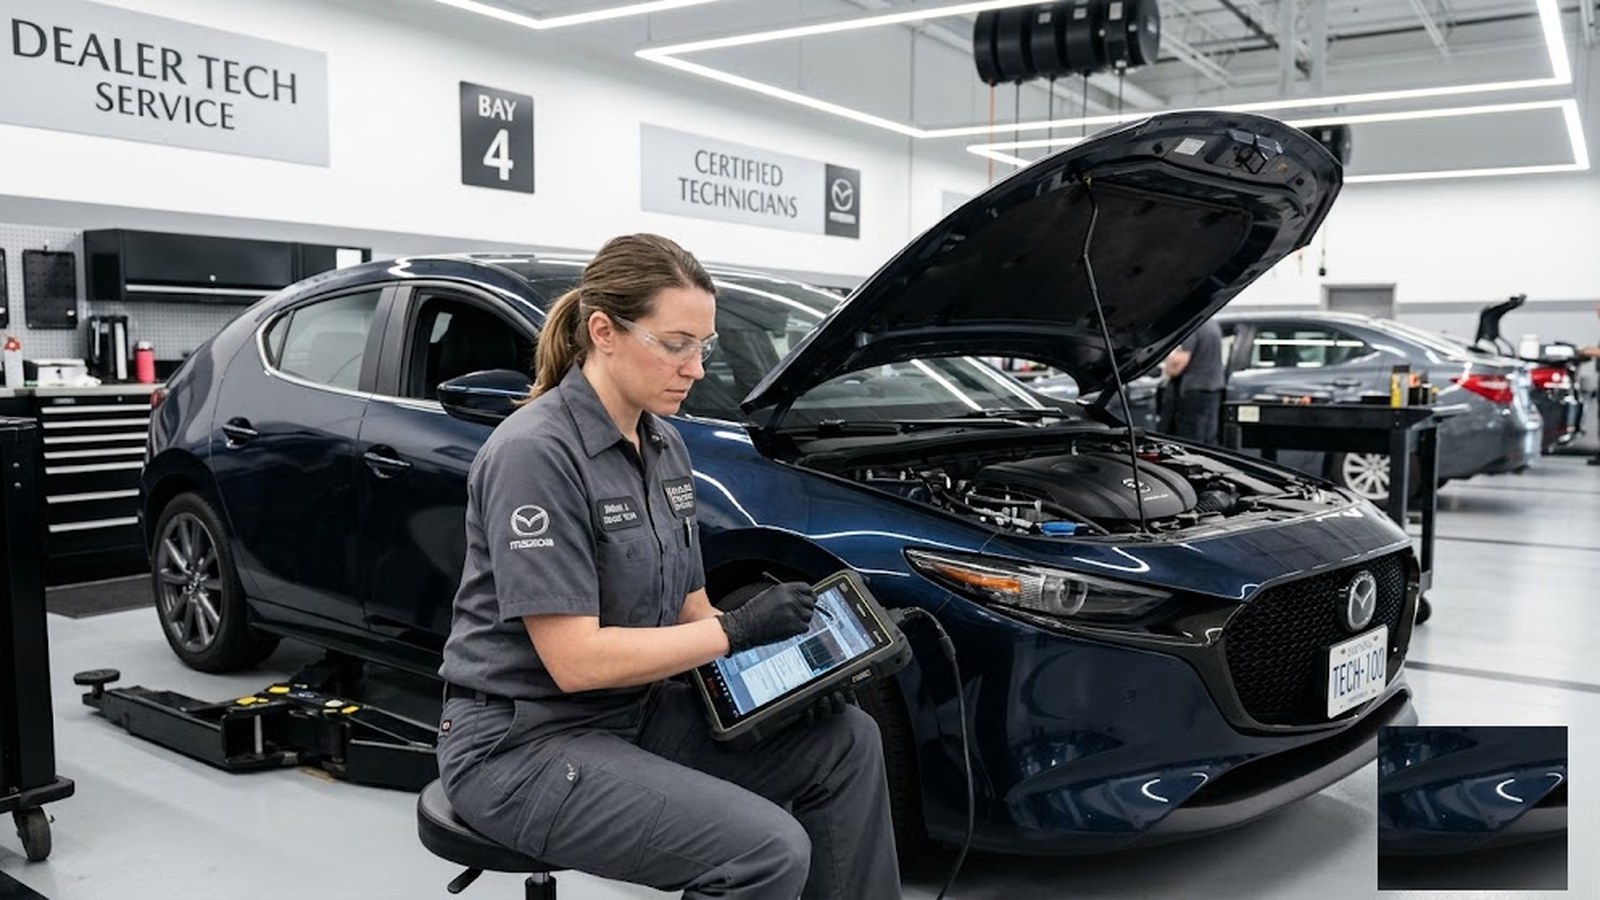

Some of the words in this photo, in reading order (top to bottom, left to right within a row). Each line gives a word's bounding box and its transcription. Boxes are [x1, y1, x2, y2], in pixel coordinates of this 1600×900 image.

[11, 18, 187, 85] DEALER
[197, 54, 297, 104] TECH
[95, 82, 236, 130] SERVICE
[478, 94, 517, 122] BAY
[483, 128, 514, 181] 4
[694, 149, 784, 188] CERTIFIED
[677, 176, 798, 218] TECHNICIANS
[1333, 646, 1384, 699] TECH-100
